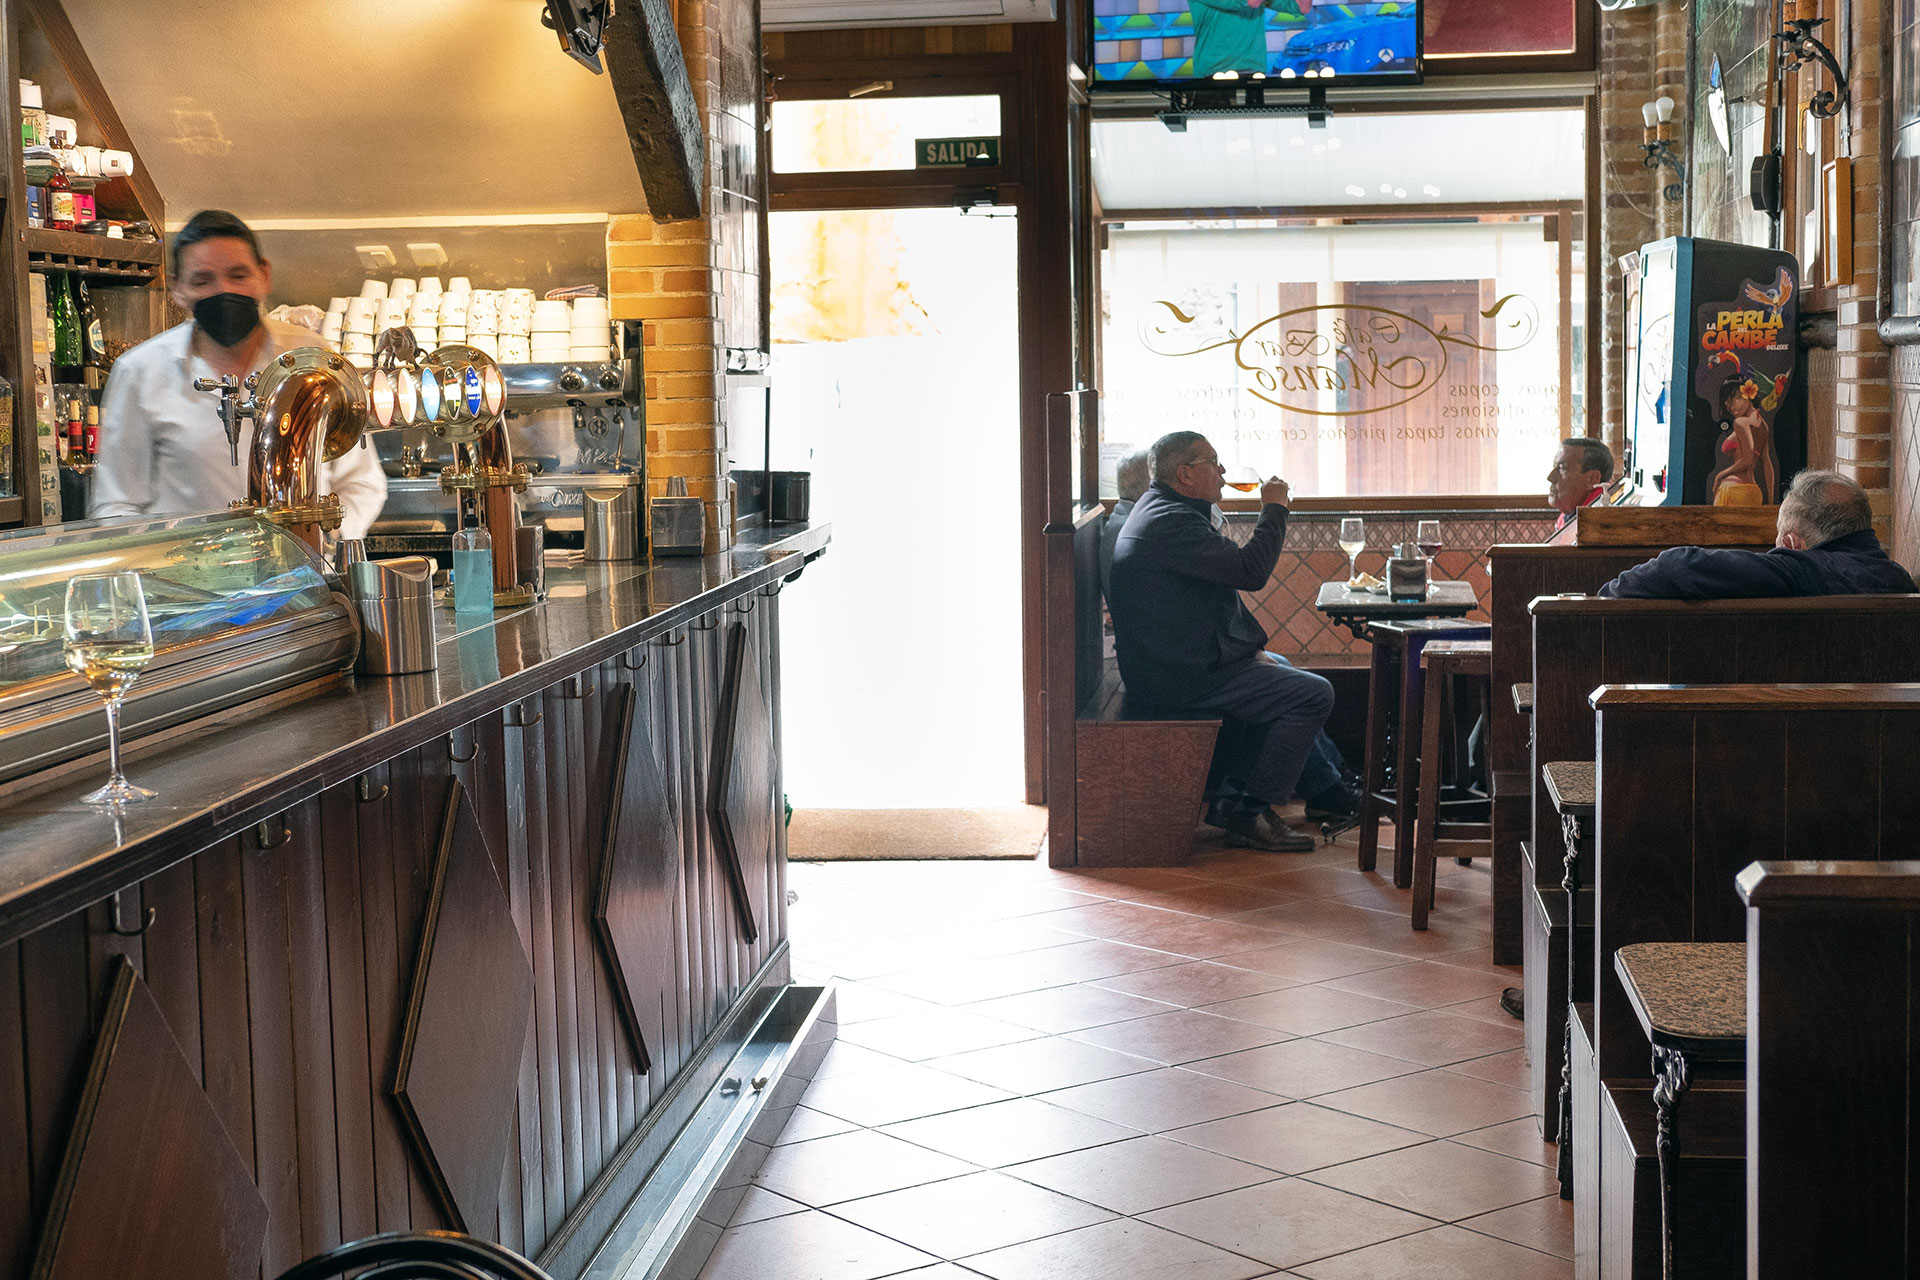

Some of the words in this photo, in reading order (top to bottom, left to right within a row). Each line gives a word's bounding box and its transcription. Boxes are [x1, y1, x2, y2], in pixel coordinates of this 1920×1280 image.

[927, 141, 988, 163] SALIDA
[1706, 322, 1717, 331] LA
[1716, 310, 1784, 332] PERLA
[1702, 329, 1778, 351] CARIBE
